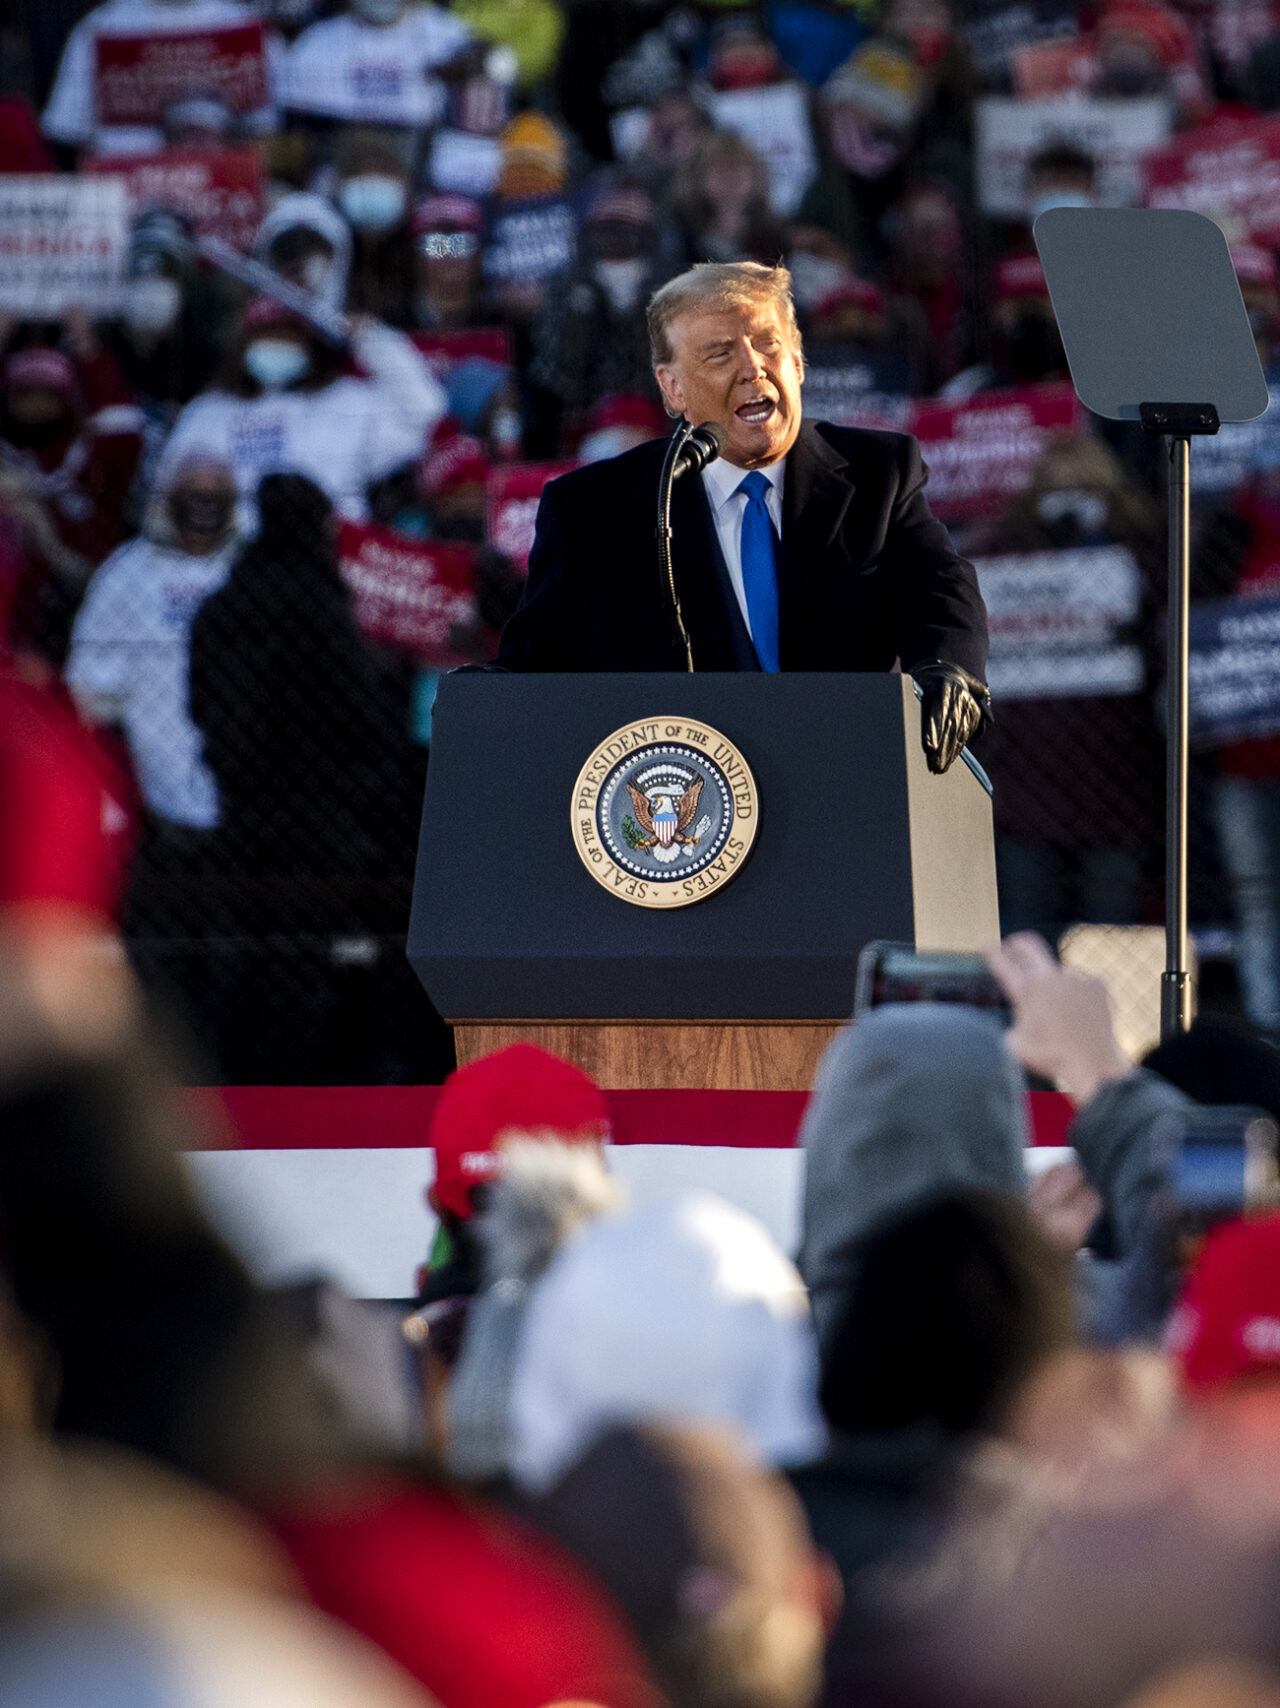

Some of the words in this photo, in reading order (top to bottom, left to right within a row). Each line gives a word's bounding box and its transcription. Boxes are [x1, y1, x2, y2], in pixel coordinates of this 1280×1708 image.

[664, 725, 681, 738] OF
[686, 727, 710, 747] THE
[578, 723, 660, 812] PRESIDENT
[713, 743, 753, 820] UNITED
[580, 817, 592, 844] THE
[587, 847, 603, 864] OF
[682, 836, 745, 897] STATES
[603, 859, 649, 899] SEAL
